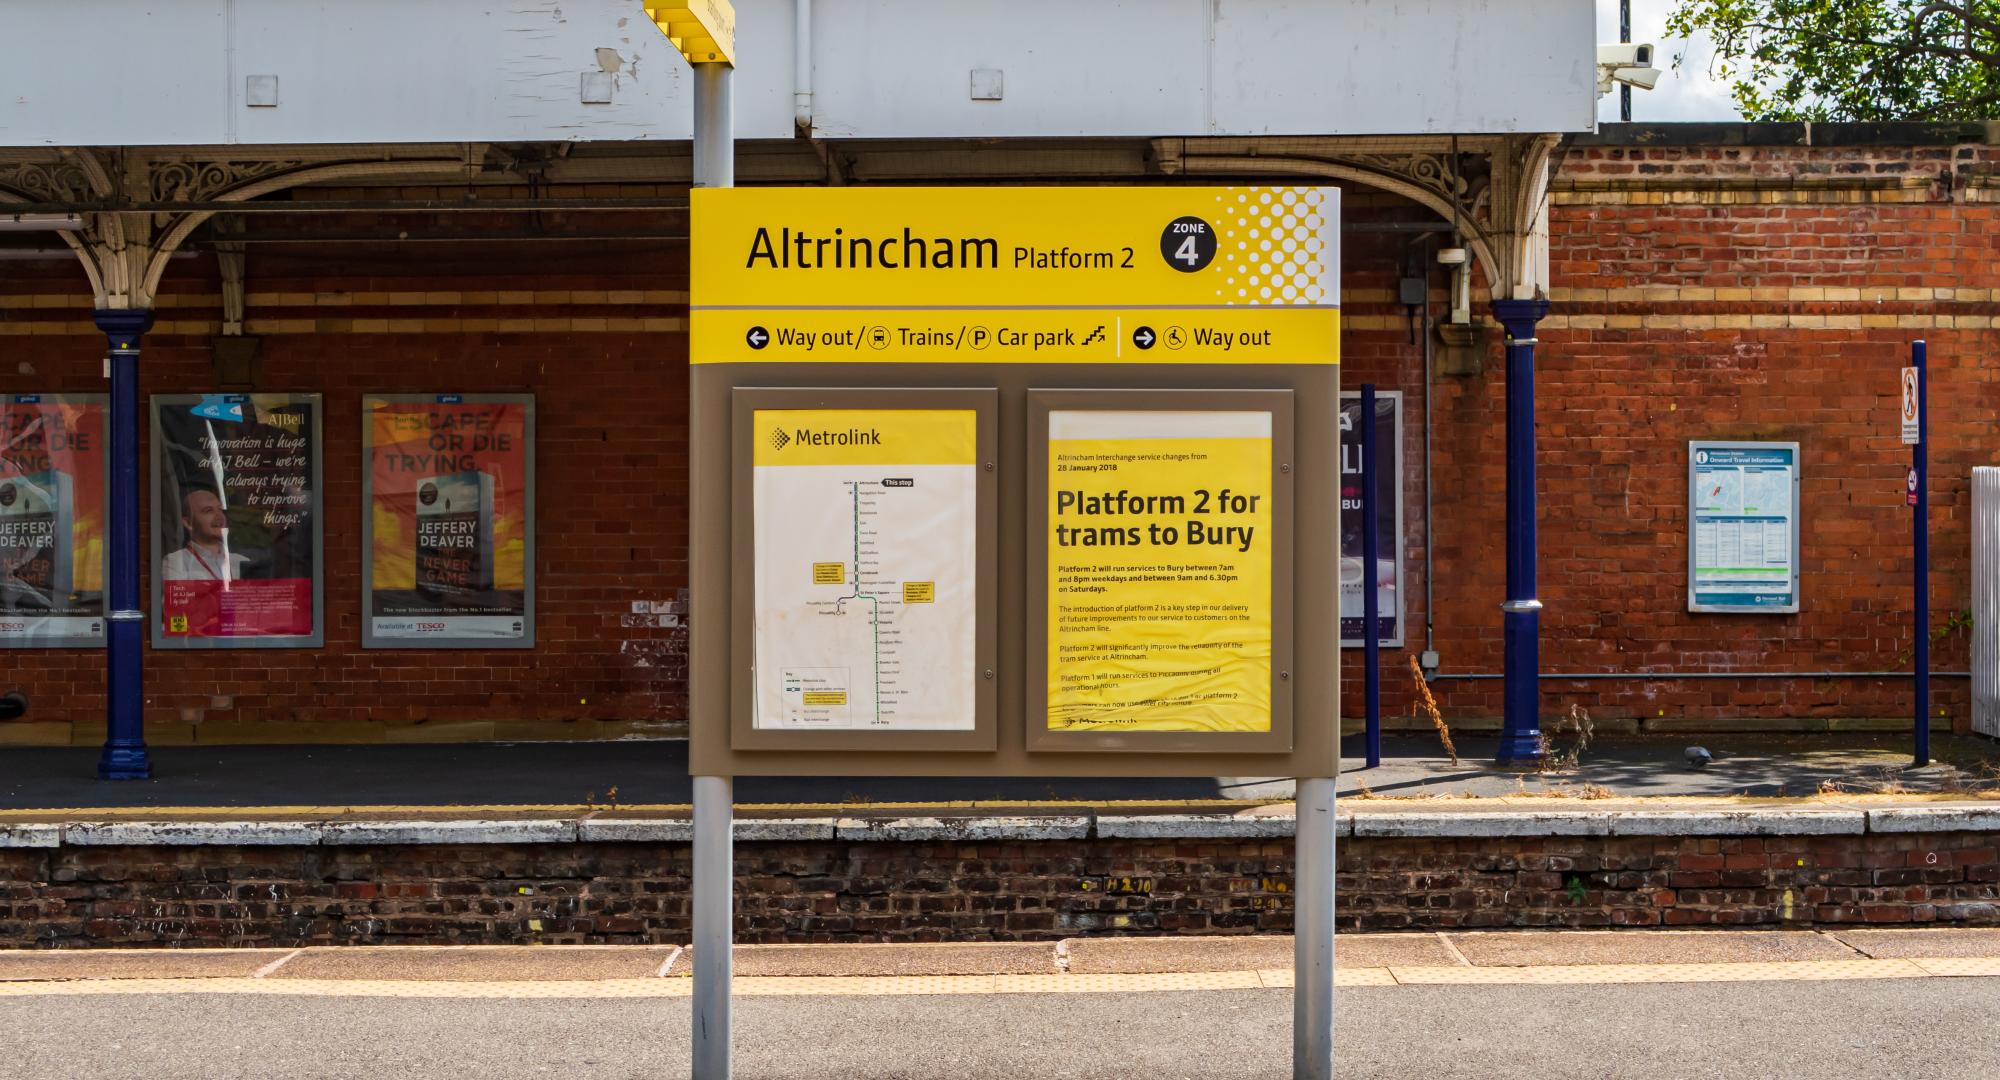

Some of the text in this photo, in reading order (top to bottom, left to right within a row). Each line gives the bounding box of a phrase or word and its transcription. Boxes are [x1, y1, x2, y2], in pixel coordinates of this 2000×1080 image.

[1173, 223, 1204, 234] ZONE
[746, 226, 1134, 269] Altrincham Platform 2
[1175, 236, 1199, 266] 4
[777, 328, 818, 351] Way
[998, 329, 1029, 346] Car
[1034, 328, 1075, 351] park
[1195, 328, 1235, 351] Way
[1240, 329, 1271, 345] out
[429, 434, 511, 451] OR DIE
[796, 429, 880, 445] Metrolink
[265, 438, 274, 448] is
[277, 434, 305, 453] huge
[235, 455, 260, 467] Bell
[276, 455, 305, 467] we're
[1162, 453, 1190, 461] changes
[226, 474, 305, 493] always trying
[248, 494, 306, 510] to improve
[1057, 489, 1260, 515] Platform 2 for
[419, 521, 476, 534] JEFFERY
[1, 536, 54, 547] DEAVER
[420, 536, 474, 548] DEAVER
[1056, 521, 1254, 552] trams to Bury
[424, 557, 470, 571] NEVER
[1167, 565, 1184, 573] Bury
[426, 570, 466, 584] GAME
[1074, 576, 1089, 584] 8pm
[1092, 575, 1126, 583] weekdays
[1210, 574, 1238, 582] 6.30pm
[1069, 585, 1107, 594] Saturdays.
[1124, 605, 1153, 613] platform
[1173, 604, 1184, 612] key
[1222, 604, 1248, 612] delivery
[1089, 615, 1137, 623] improvements
[1109, 644, 1148, 652] significantly
[1061, 674, 1090, 682] Platform
[1097, 672, 1108, 680] will
[1062, 683, 1099, 692] operational
